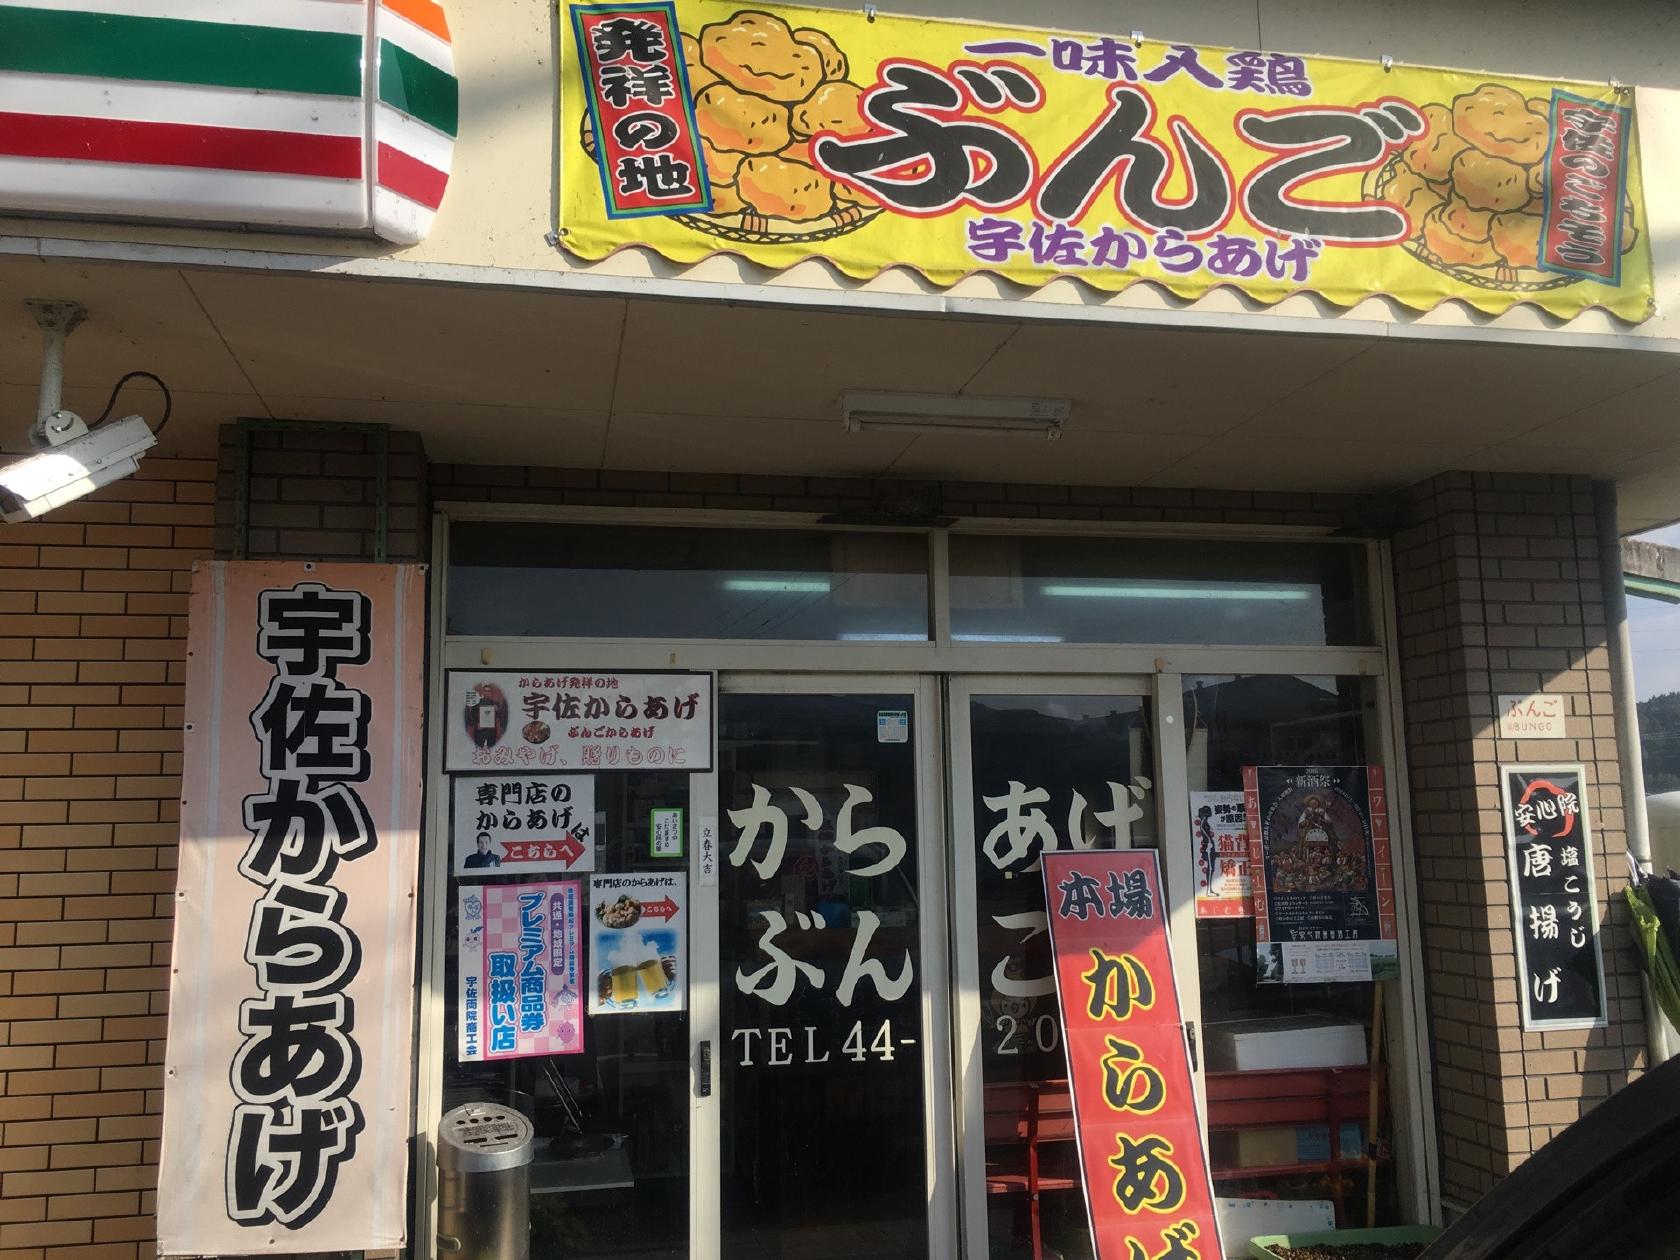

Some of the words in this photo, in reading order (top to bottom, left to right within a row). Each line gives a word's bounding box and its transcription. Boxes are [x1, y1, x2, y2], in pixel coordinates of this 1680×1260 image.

[964, 37, 1312, 97] 一味入鶏
[594, 17, 693, 198] 発祥の地
[811, 60, 1426, 245] ぶんご
[968, 219, 1323, 282] 宇佐からあげ
[518, 677, 619, 689] からあげ発祥の地
[521, 692, 699, 720] 宇佐からあげ
[1508, 700, 1558, 718] ぶんご
[1514, 722, 1552, 731] BUNGO
[475, 782, 572, 805] 専門店の
[1513, 792, 1580, 827] 安心院
[509, 844, 575, 859] こちらへ
[703, 827, 713, 874] 立春大吉
[229, 584, 376, 1227] 宇佐からあげ
[1057, 869, 1154, 920] 本場
[1560, 846, 1586, 949] 塩こうじ
[1523, 843, 1563, 1004] 唐揚げ
[518, 892, 547, 1032] プレミアム商品券
[489, 952, 517, 1053] 取扱い店
[731, 1026, 830, 1067] TEL
